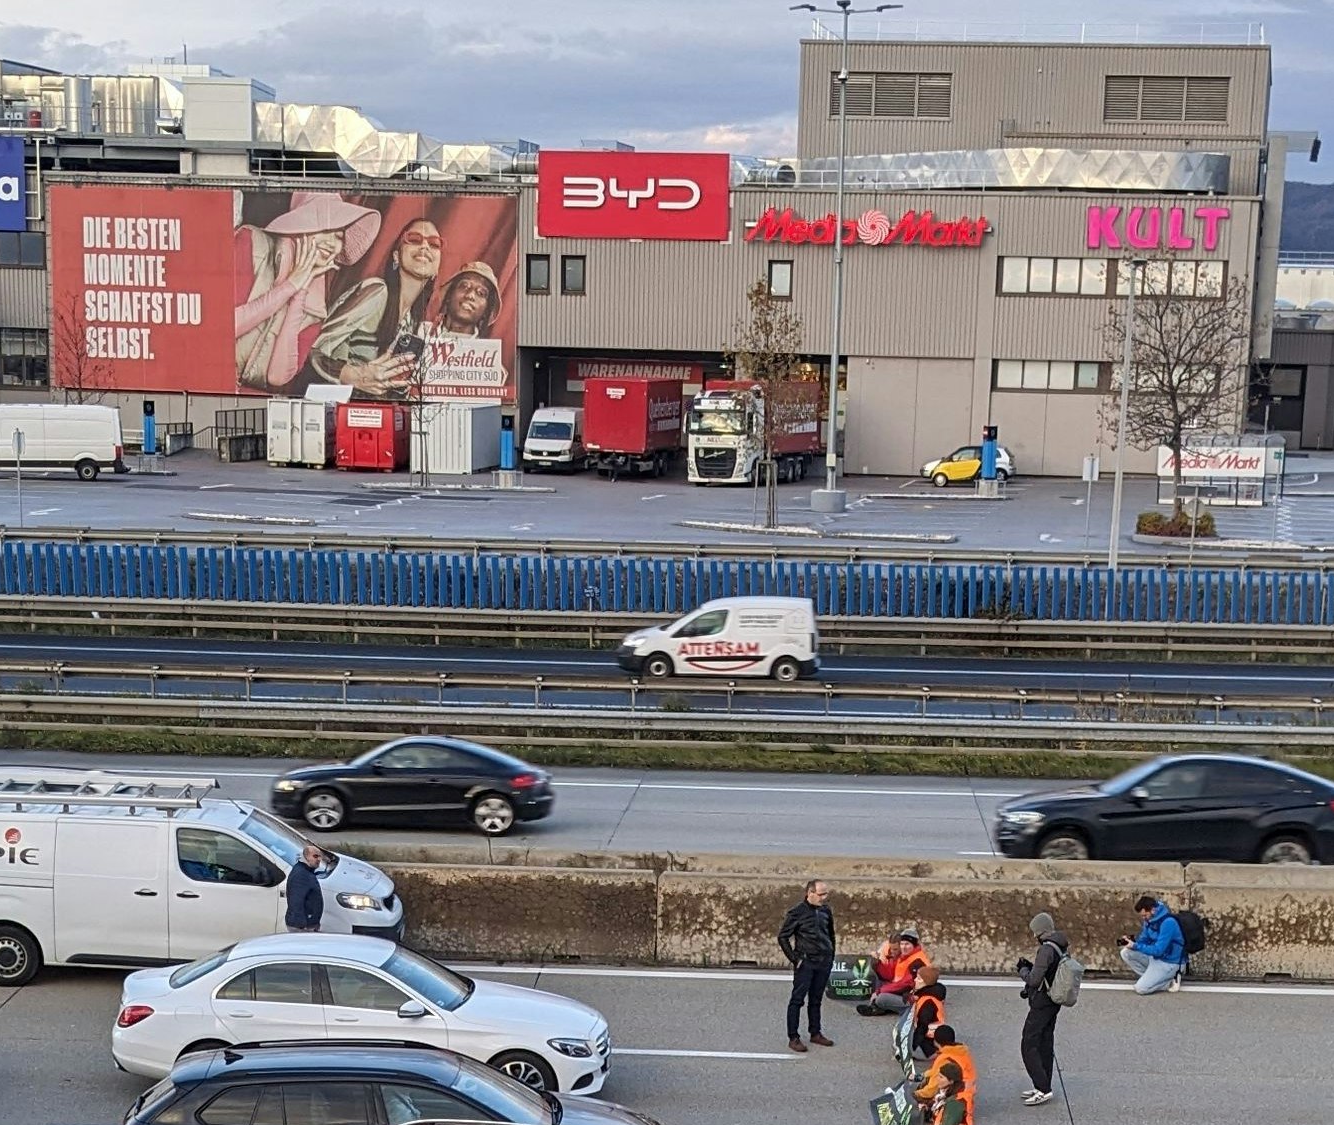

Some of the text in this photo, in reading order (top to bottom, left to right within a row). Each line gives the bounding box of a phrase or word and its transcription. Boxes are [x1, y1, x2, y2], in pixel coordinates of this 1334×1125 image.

[562, 176, 702, 210] BYD
[83, 215, 181, 252] DIE BESTEN
[889, 210, 990, 248] Markt
[1086, 205, 1231, 250] KULT
[83, 254, 166, 288] MOMENTE
[84, 290, 202, 326] SCHAFFST DU
[85, 326, 155, 361] SELBST.
[428, 340, 498, 368] Westfield
[429, 369, 465, 381] SHOPPING
[466, 370, 483, 382] CITY
[578, 363, 692, 380] WARENANNAHME
[460, 388, 476, 396] LESS
[1219, 454, 1260, 470] Markt
[677, 640, 760, 656] ATTENSAM
